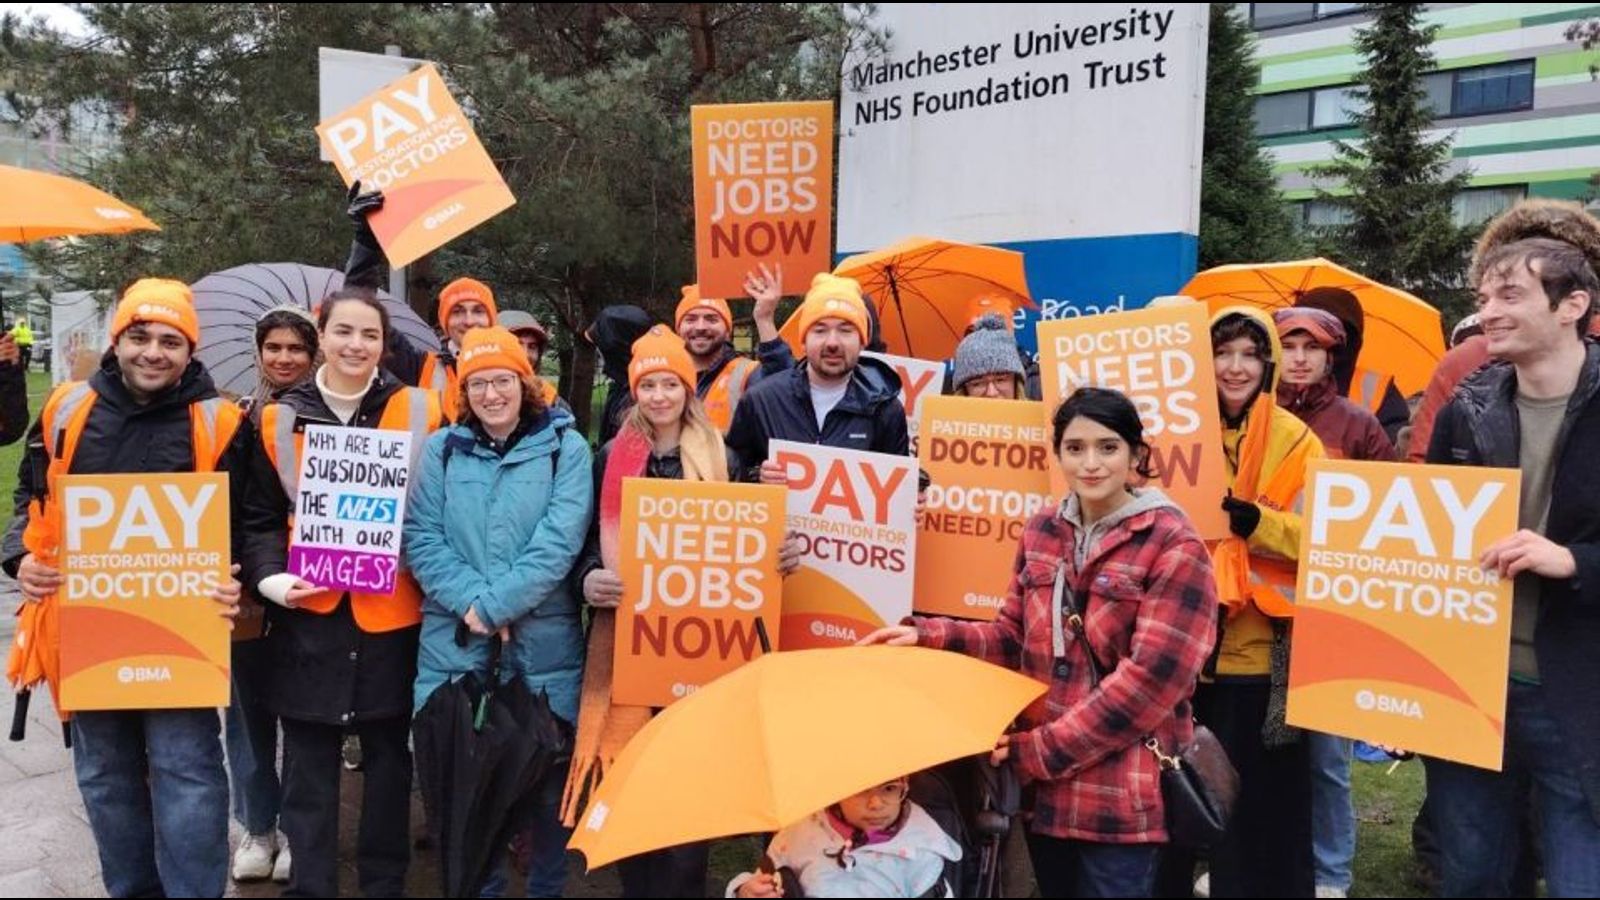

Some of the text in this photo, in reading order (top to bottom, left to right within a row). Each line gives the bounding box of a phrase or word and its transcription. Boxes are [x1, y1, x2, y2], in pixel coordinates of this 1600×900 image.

[852, 8, 1174, 88] Manchester University
[855, 51, 1167, 125] NHS Foundation Trust
[326, 75, 437, 169] PAY
[707, 117, 819, 140] DOCTORS
[708, 140, 818, 176] NEED
[710, 176, 818, 222] JOBS
[710, 219, 816, 258] NOW
[1055, 322, 1192, 358] DOCTORS
[1057, 349, 1195, 400] NEED
[931, 419, 1013, 438] PATIENTS
[1133, 391, 1201, 437] BS
[308, 431, 404, 459] WHY ARE WE
[930, 437, 1050, 471] DOCTOR
[304, 456, 408, 488] SUBSIDISING
[776, 451, 909, 525] PAY
[64, 483, 218, 551] PAY
[301, 490, 393, 522] THE NHS
[638, 495, 770, 524] DOCTORS
[1311, 471, 1507, 561] PAY
[300, 524, 394, 548] WITH OUR
[635, 521, 767, 564] NEED
[877, 529, 907, 546] FOR
[924, 512, 991, 537] NEED
[67, 552, 220, 569] RESTORATION FOR
[299, 552, 397, 590] WAGES?
[1308, 550, 1500, 587] RESTORATION FOR
[67, 570, 221, 600] DOCTORS
[634, 563, 764, 612] JOBS
[1305, 570, 1498, 625] DOCTORS
[631, 614, 758, 662] NOW
[826, 624, 857, 641] BMA
[136, 667, 171, 682] BMA
[1377, 696, 1424, 719] BMA
